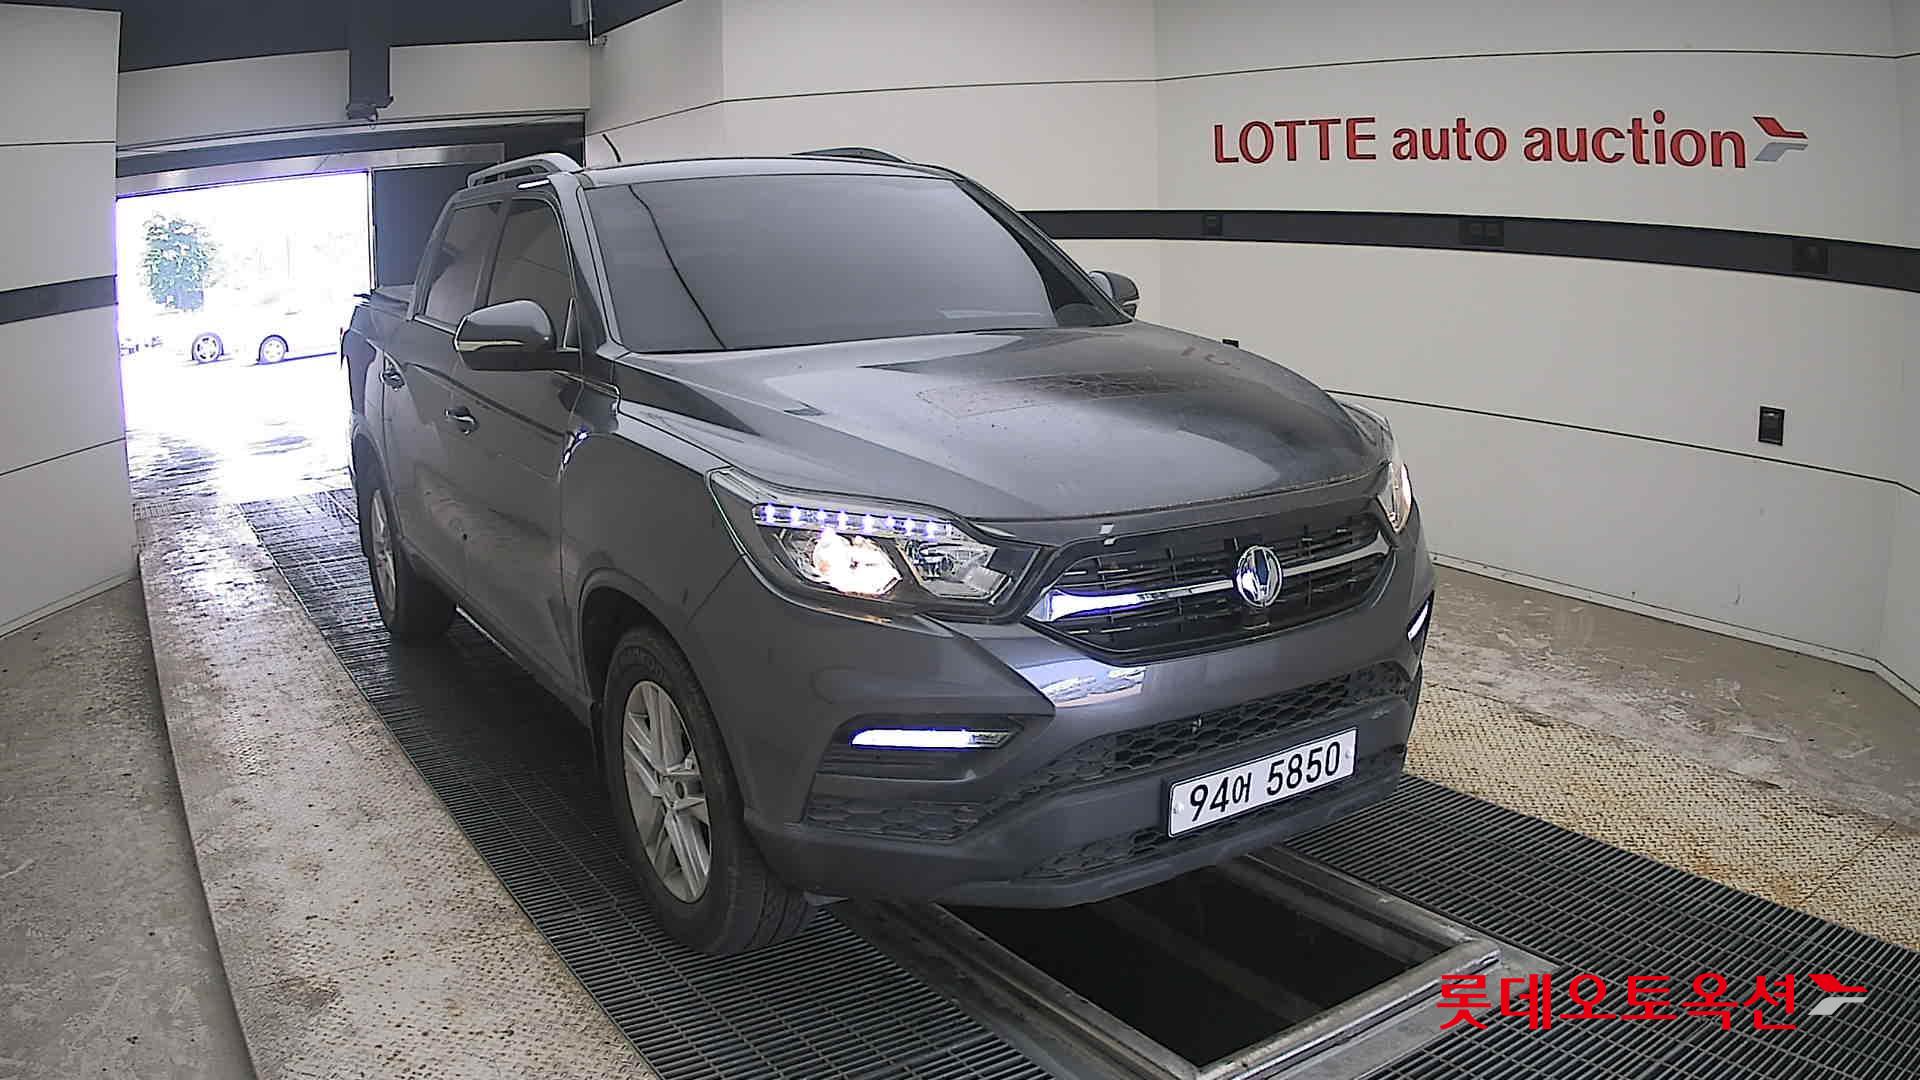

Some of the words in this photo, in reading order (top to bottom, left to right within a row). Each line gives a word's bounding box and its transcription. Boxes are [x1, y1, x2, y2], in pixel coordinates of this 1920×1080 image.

[1214, 117, 1377, 163] LOTTE
[1392, 117, 1508, 161] auto
[1523, 110, 1747, 168] auction
[1190, 772, 1252, 822] 94어
[1266, 741, 1341, 796] 5850
